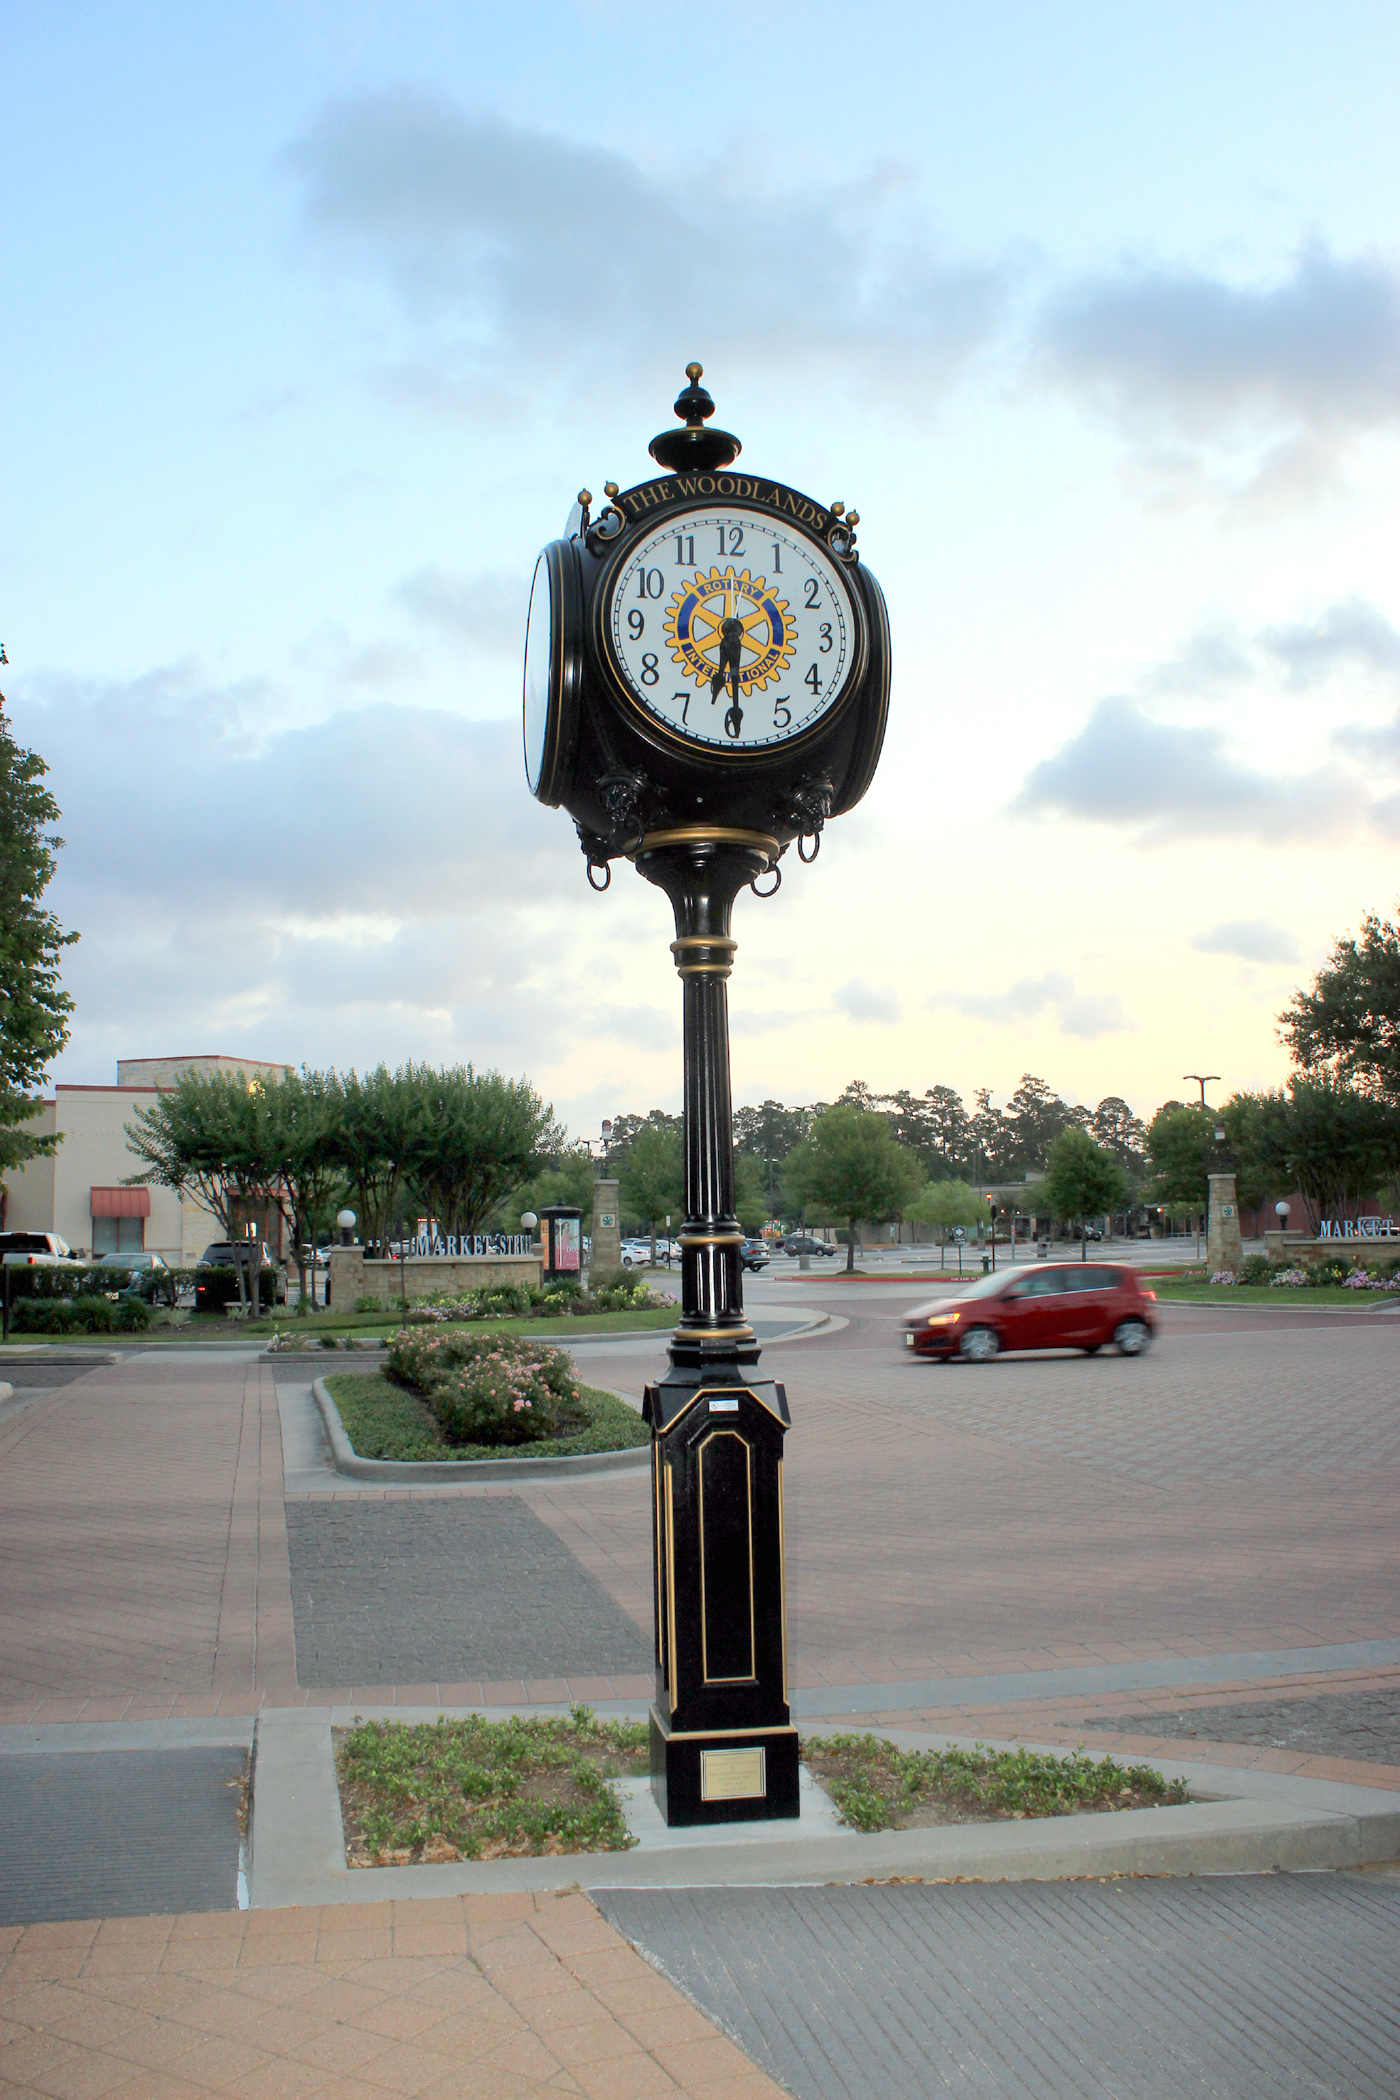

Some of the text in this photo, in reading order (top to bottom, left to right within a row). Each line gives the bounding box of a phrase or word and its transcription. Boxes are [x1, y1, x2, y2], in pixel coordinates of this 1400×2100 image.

[623, 476, 828, 531] THE WOODLANDS
[674, 535, 697, 566] 11
[716, 525, 747, 558] 12
[771, 543, 783, 574] 1
[636, 567, 664, 600] 10
[703, 580, 759, 597] ROTARY
[803, 578, 823, 609] 2
[627, 608, 645, 641] 9
[819, 622, 833, 653] 3
[640, 652, 660, 686] 8
[685, 648, 779, 682] INTERTIONAL
[804, 662, 823, 695] 4
[671, 692, 690, 726] 7
[773, 695, 792, 728] 5
[1320, 1219, 1394, 1238] MARKET
[415, 1235, 491, 1256] MARKET
